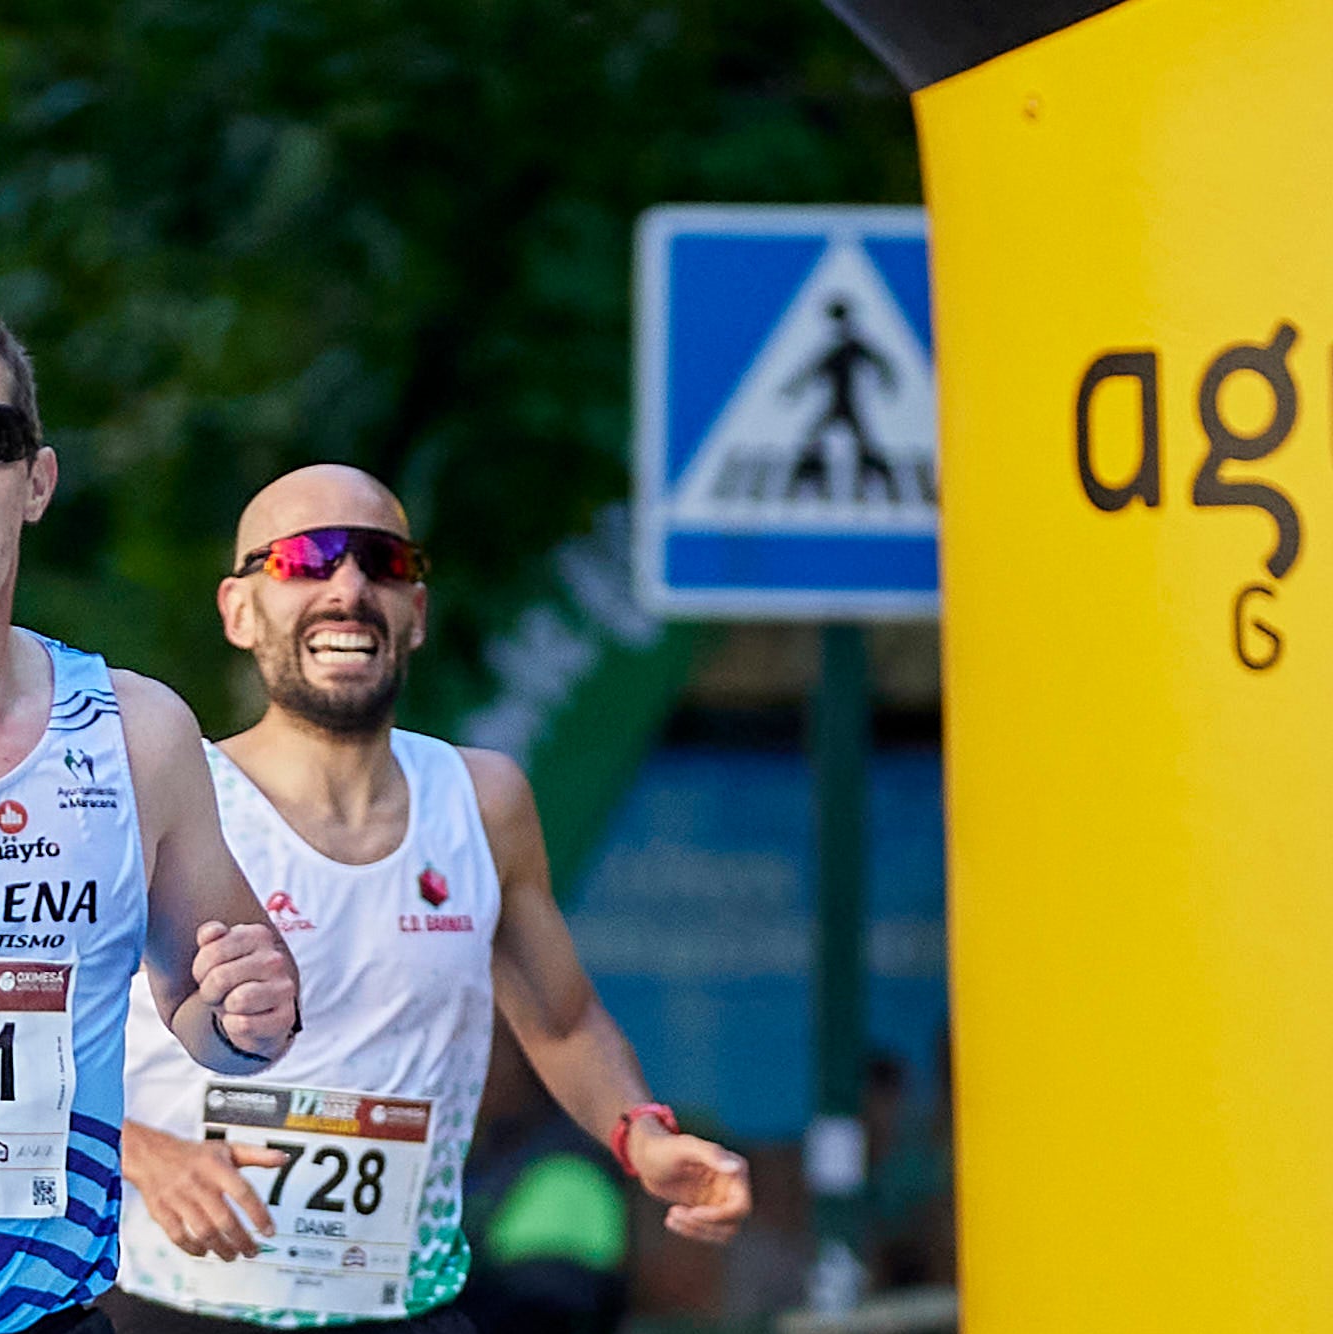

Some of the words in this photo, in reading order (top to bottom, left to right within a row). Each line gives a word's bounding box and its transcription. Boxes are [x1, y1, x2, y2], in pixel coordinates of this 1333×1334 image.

[1075, 320, 1333, 580] ag
[16, 971, 65, 984] OXIMESA
[266, 1141, 386, 1216] 728
[293, 1216, 348, 1239] DANIEL
